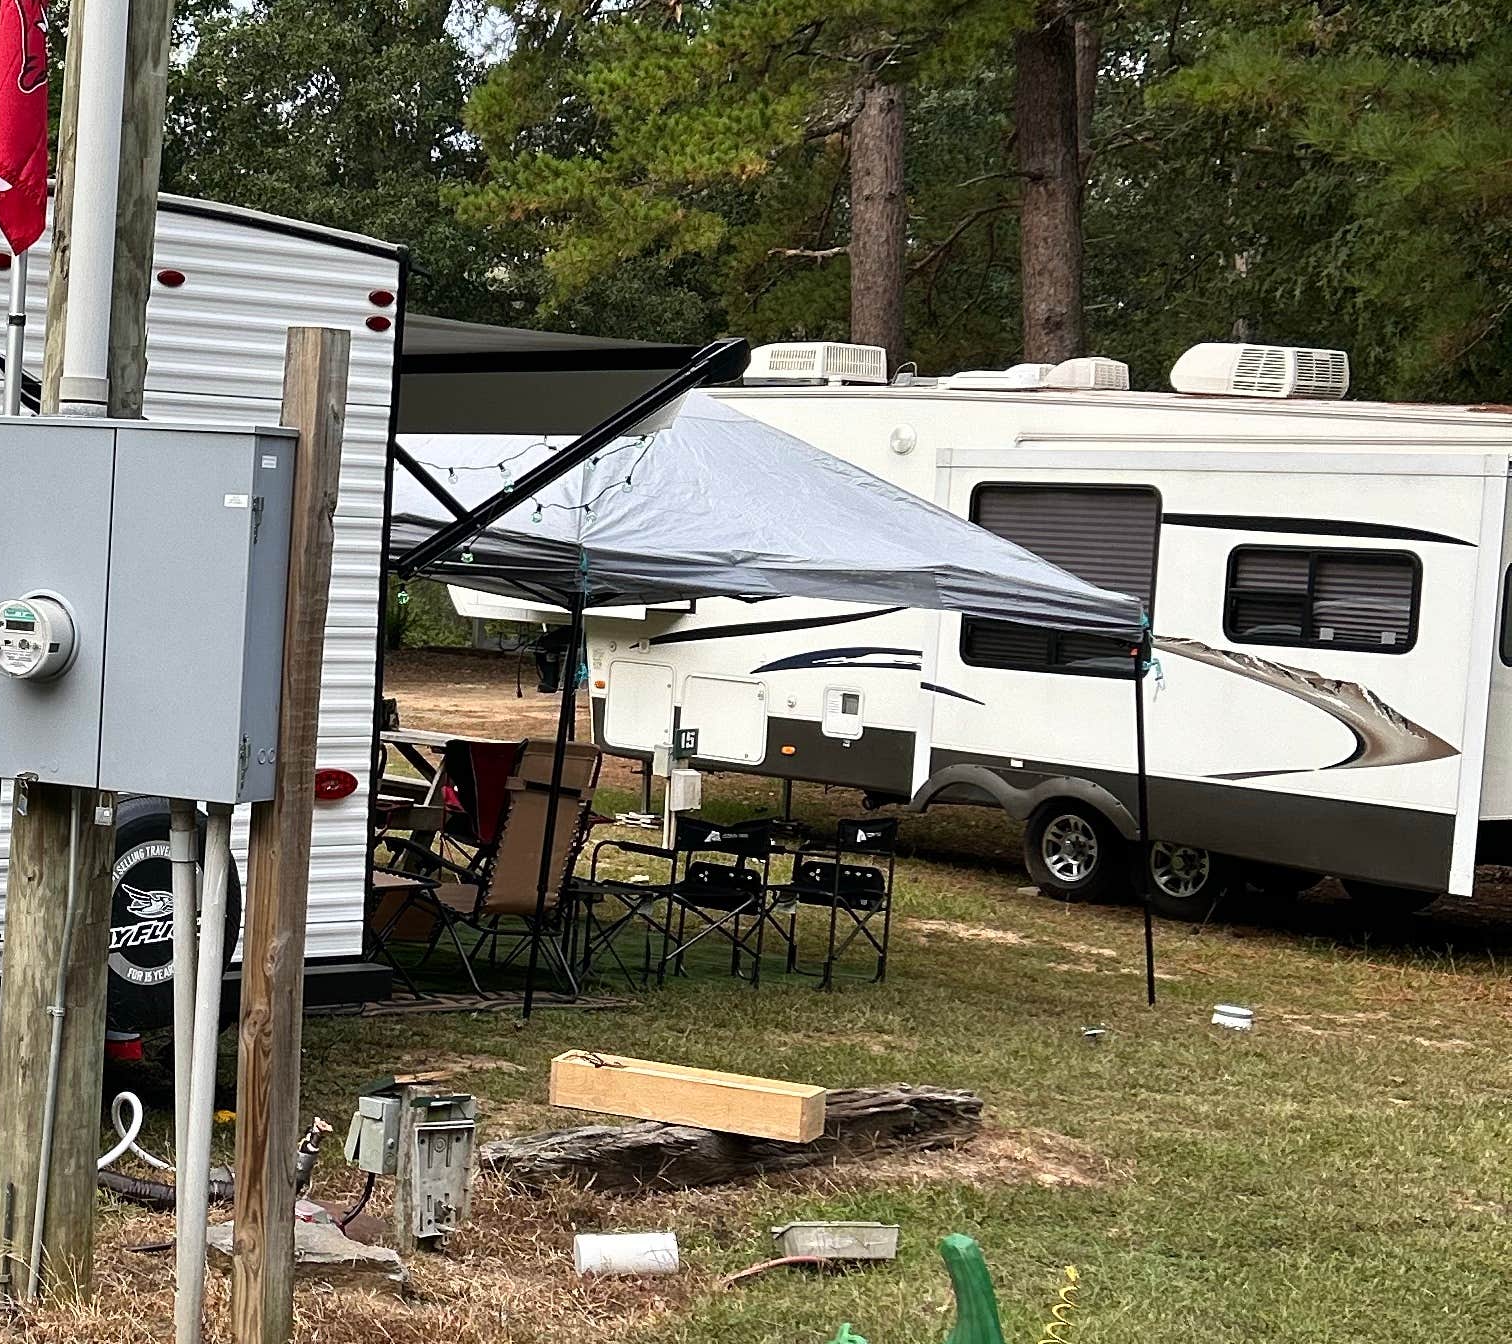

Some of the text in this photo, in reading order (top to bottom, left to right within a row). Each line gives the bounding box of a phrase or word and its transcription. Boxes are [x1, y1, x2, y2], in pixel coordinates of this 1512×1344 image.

[681, 731, 696, 749] 15
[116, 848, 145, 875] SELLING
[128, 968, 143, 982] FOR
[153, 963, 176, 981] YEAR
